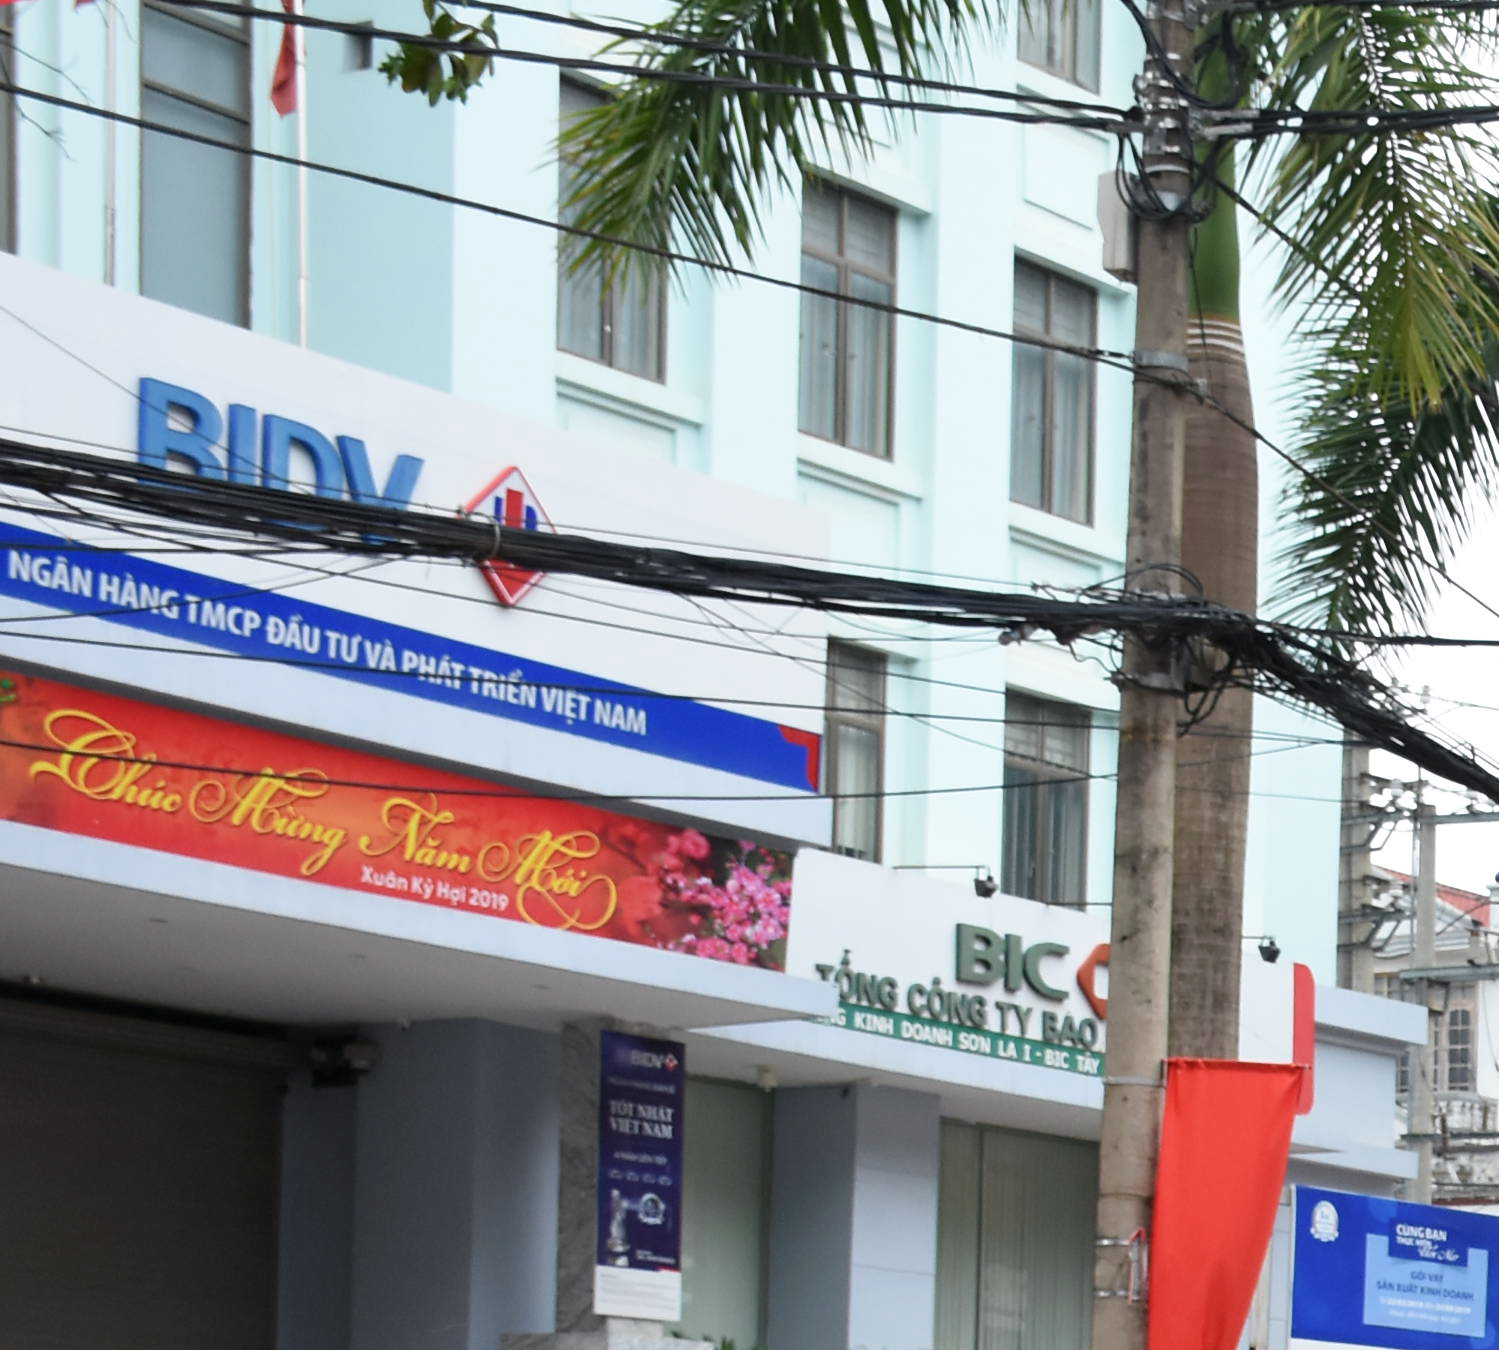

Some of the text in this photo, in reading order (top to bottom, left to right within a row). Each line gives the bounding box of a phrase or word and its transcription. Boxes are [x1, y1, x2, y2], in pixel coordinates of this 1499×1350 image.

[137, 377, 425, 545] BIDV
[8, 549, 647, 736] NGÂN HÀNG TMCP ĐẦU TƯ VÀ PHÁT TRIỂN VIỆT NAM
[29, 708, 182, 814] Chúc
[360, 791, 472, 875] Năm
[361, 865, 408, 890] Xuân
[469, 887, 510, 911] 2019
[956, 923, 1070, 1001] BIC
[854, 1011, 895, 1034] KINH
[901, 1022, 953, 1047] DOANH
[999, 1040, 1017, 1060] LA
[995, 1001, 1033, 1038] TY
